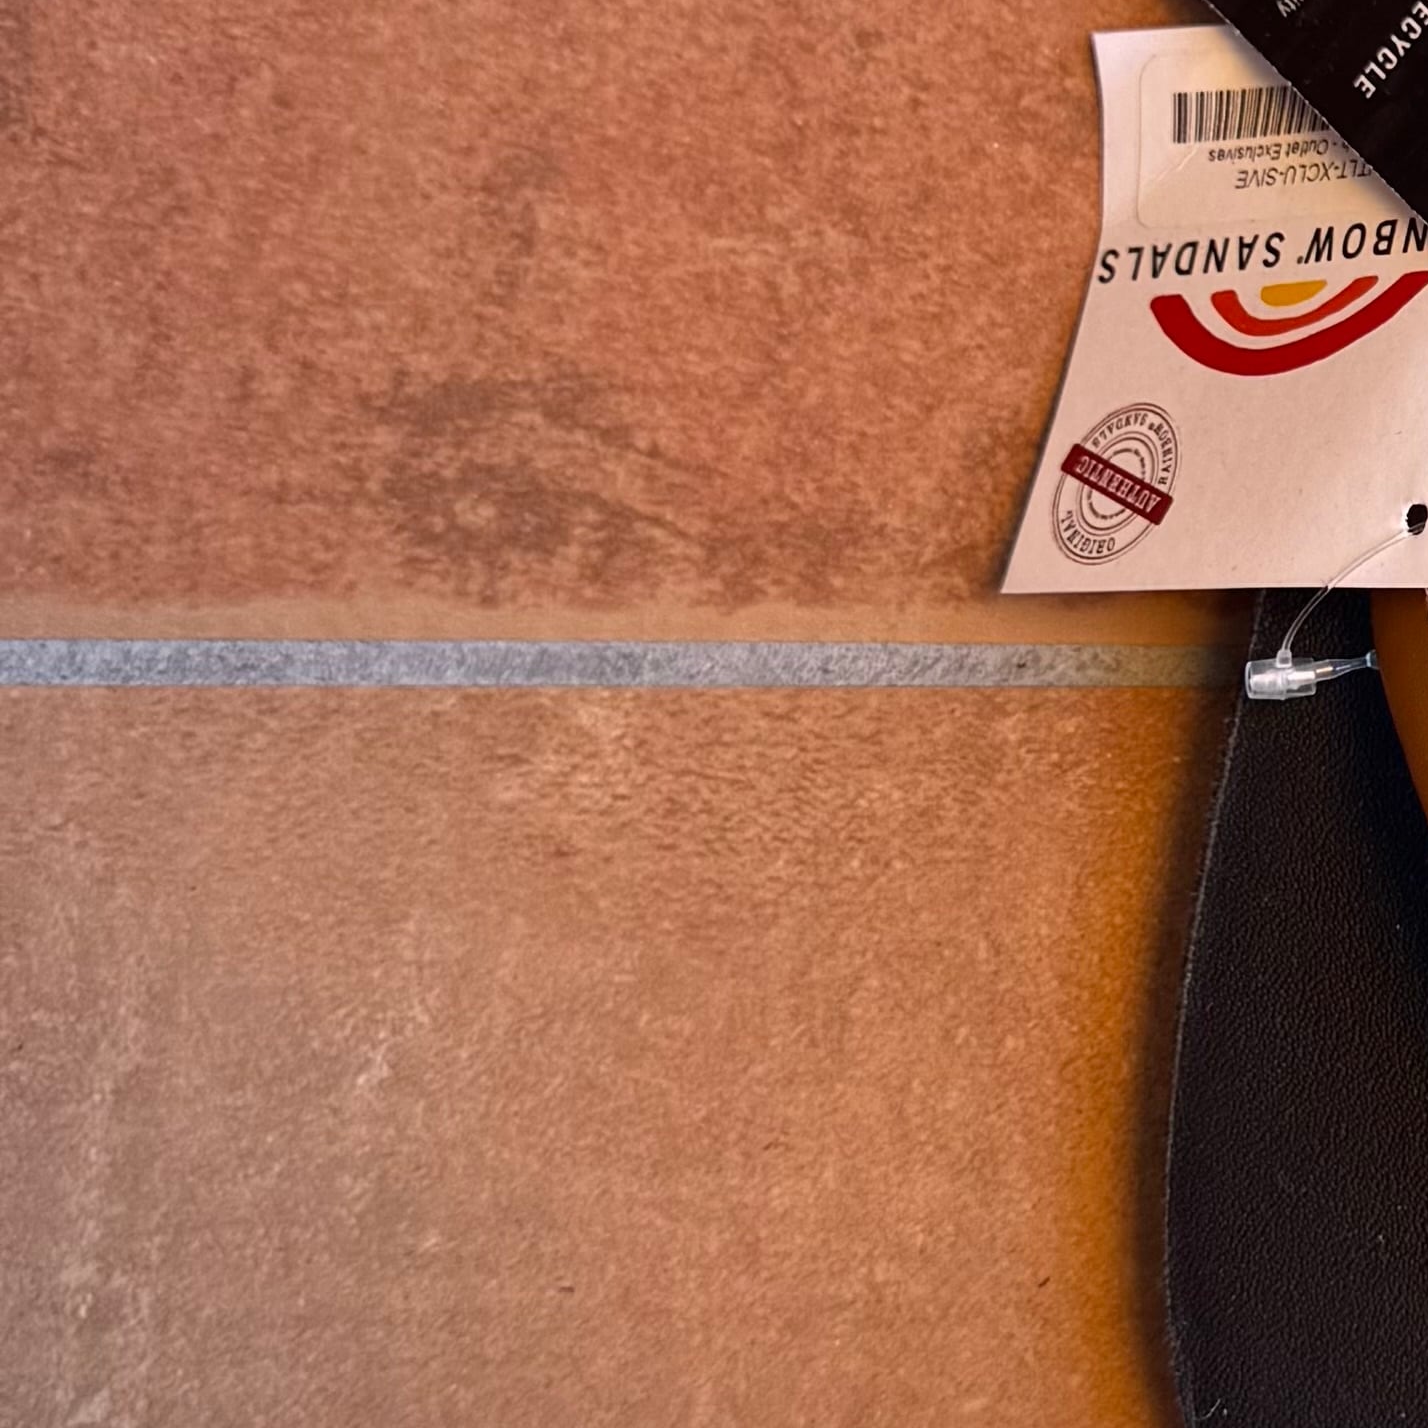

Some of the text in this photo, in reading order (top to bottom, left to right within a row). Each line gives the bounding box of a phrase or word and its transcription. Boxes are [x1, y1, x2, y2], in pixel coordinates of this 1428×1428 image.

[1208, 143, 1281, 164] Exclusives
[1284, 140, 1329, 159] Outlet
[1235, 160, 1373, 190] TLT-XCLU-SIVE
[1097, 232, 1285, 284] SANDALS
[1091, 412, 1149, 449] SANDALS
[1075, 455, 1162, 514] AUTHENTIC
[1061, 510, 1116, 555] ORIGINAL
